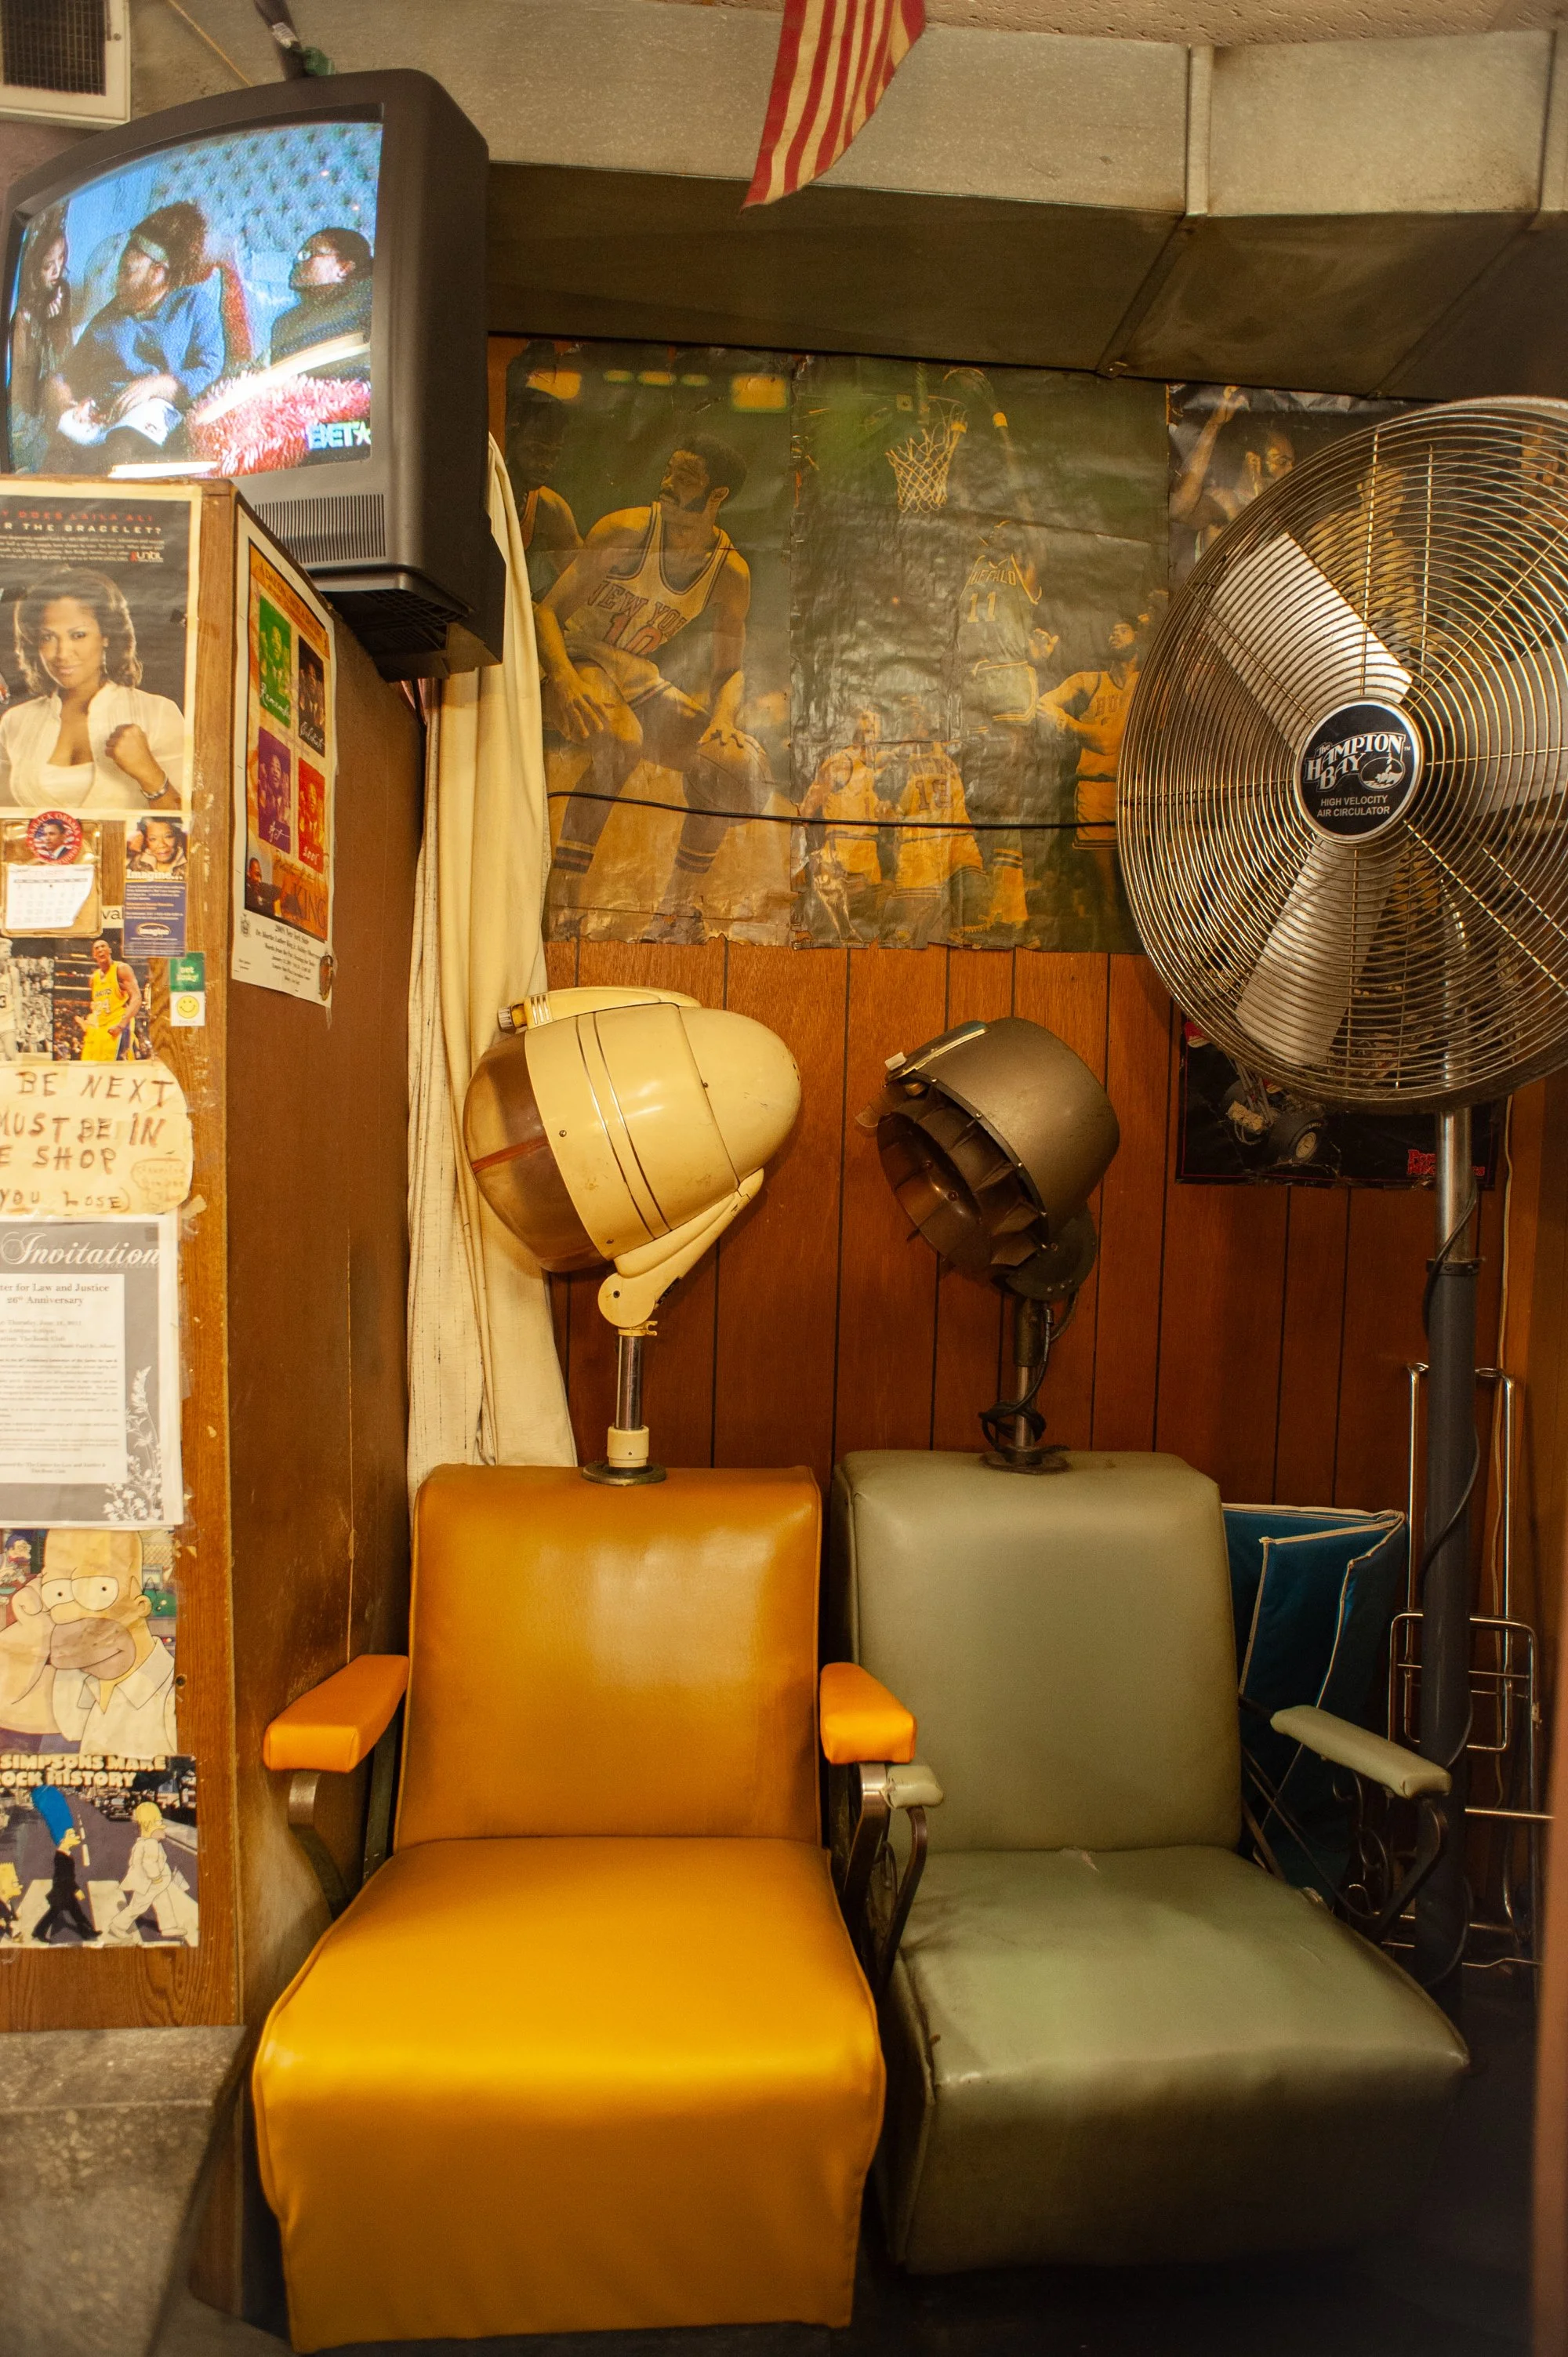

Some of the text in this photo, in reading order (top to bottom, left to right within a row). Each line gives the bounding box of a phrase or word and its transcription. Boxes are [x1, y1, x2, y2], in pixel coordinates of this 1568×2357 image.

[305, 422, 358, 449] BET
[19, 510, 63, 521] DOES
[23, 523, 54, 532] THE
[64, 525, 162, 535] BRACELET?
[967, 591, 996, 623] 11
[1307, 733, 1403, 782] HAMPTON
[1319, 753, 1366, 790] BAY
[1317, 806, 1390, 818] AIR CIRCULATOR
[1321, 795, 1388, 807] HIGH VELOCITY
[16, 1071, 175, 1107] BE NEXT
[78, 1117, 112, 1143] BE
[129, 1113, 166, 1146] IN
[32, 1146, 117, 1175] SHOP
[2, 1231, 159, 1265] Invitation
[16, 1283, 29, 1291] for
[33, 1283, 52, 1292] Law
[56, 1284, 72, 1292] and
[74, 1283, 110, 1292] Justice
[27, 1295, 84, 1306] Anniversary
[0, 1754, 167, 1771] SIMPSONS MAKE
[0, 1769, 137, 1788] OCK HISTORY
